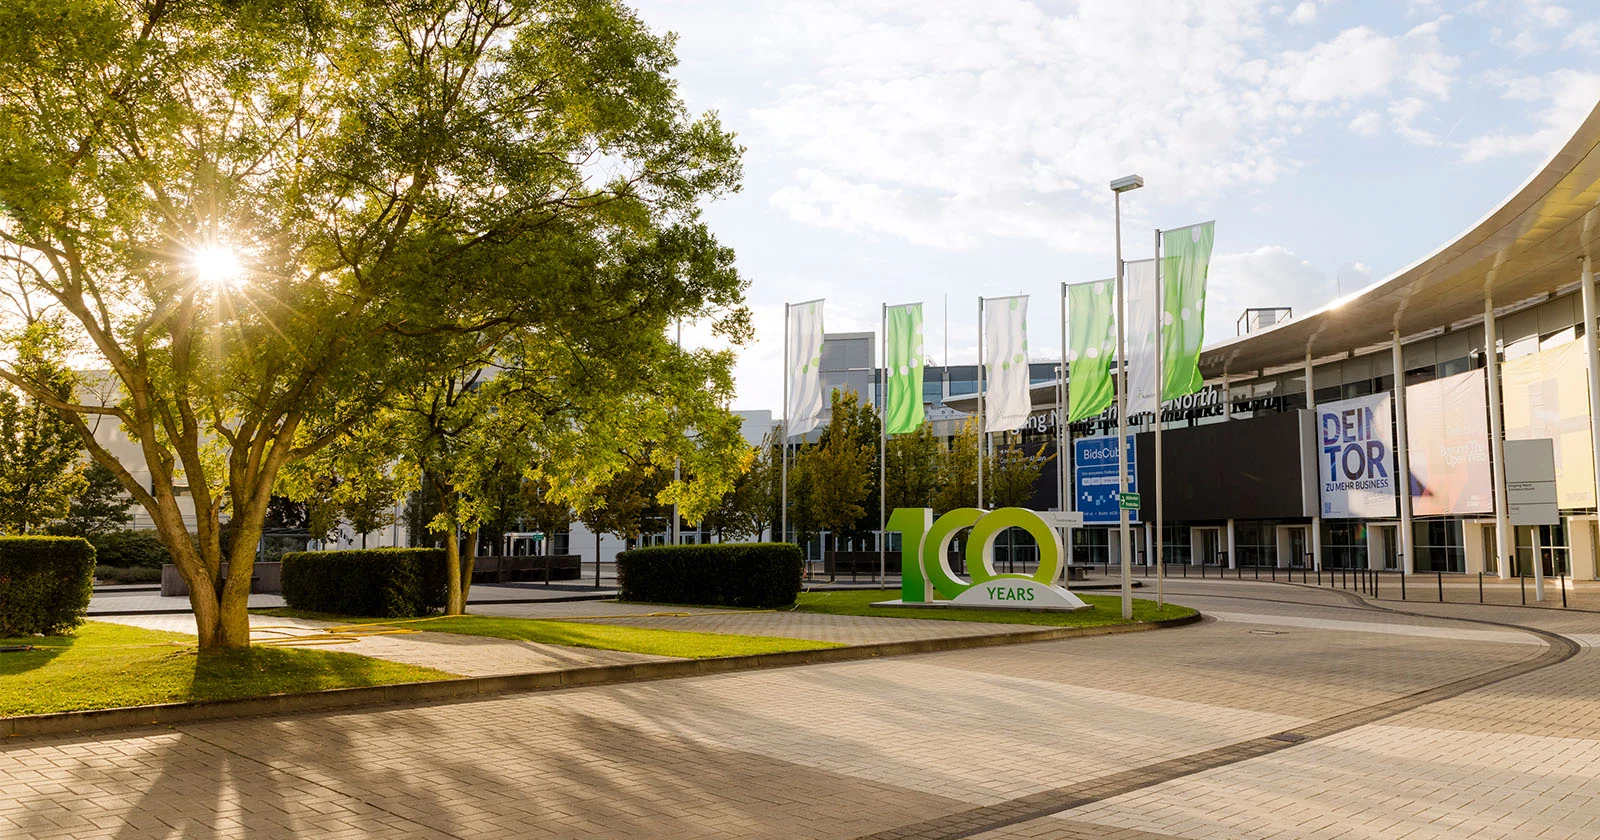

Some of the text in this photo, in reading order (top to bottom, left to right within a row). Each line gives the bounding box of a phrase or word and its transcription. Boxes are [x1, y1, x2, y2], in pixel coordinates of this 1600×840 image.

[1169, 384, 1218, 411] North
[1322, 406, 1381, 446] DEIN
[1083, 447, 1120, 460] BidsCub
[1324, 440, 1388, 482] TOR
[1326, 479, 1389, 492] ZU MEHR BUSINESS
[886, 507, 1063, 603] 100
[986, 586, 1035, 601] YEARS
